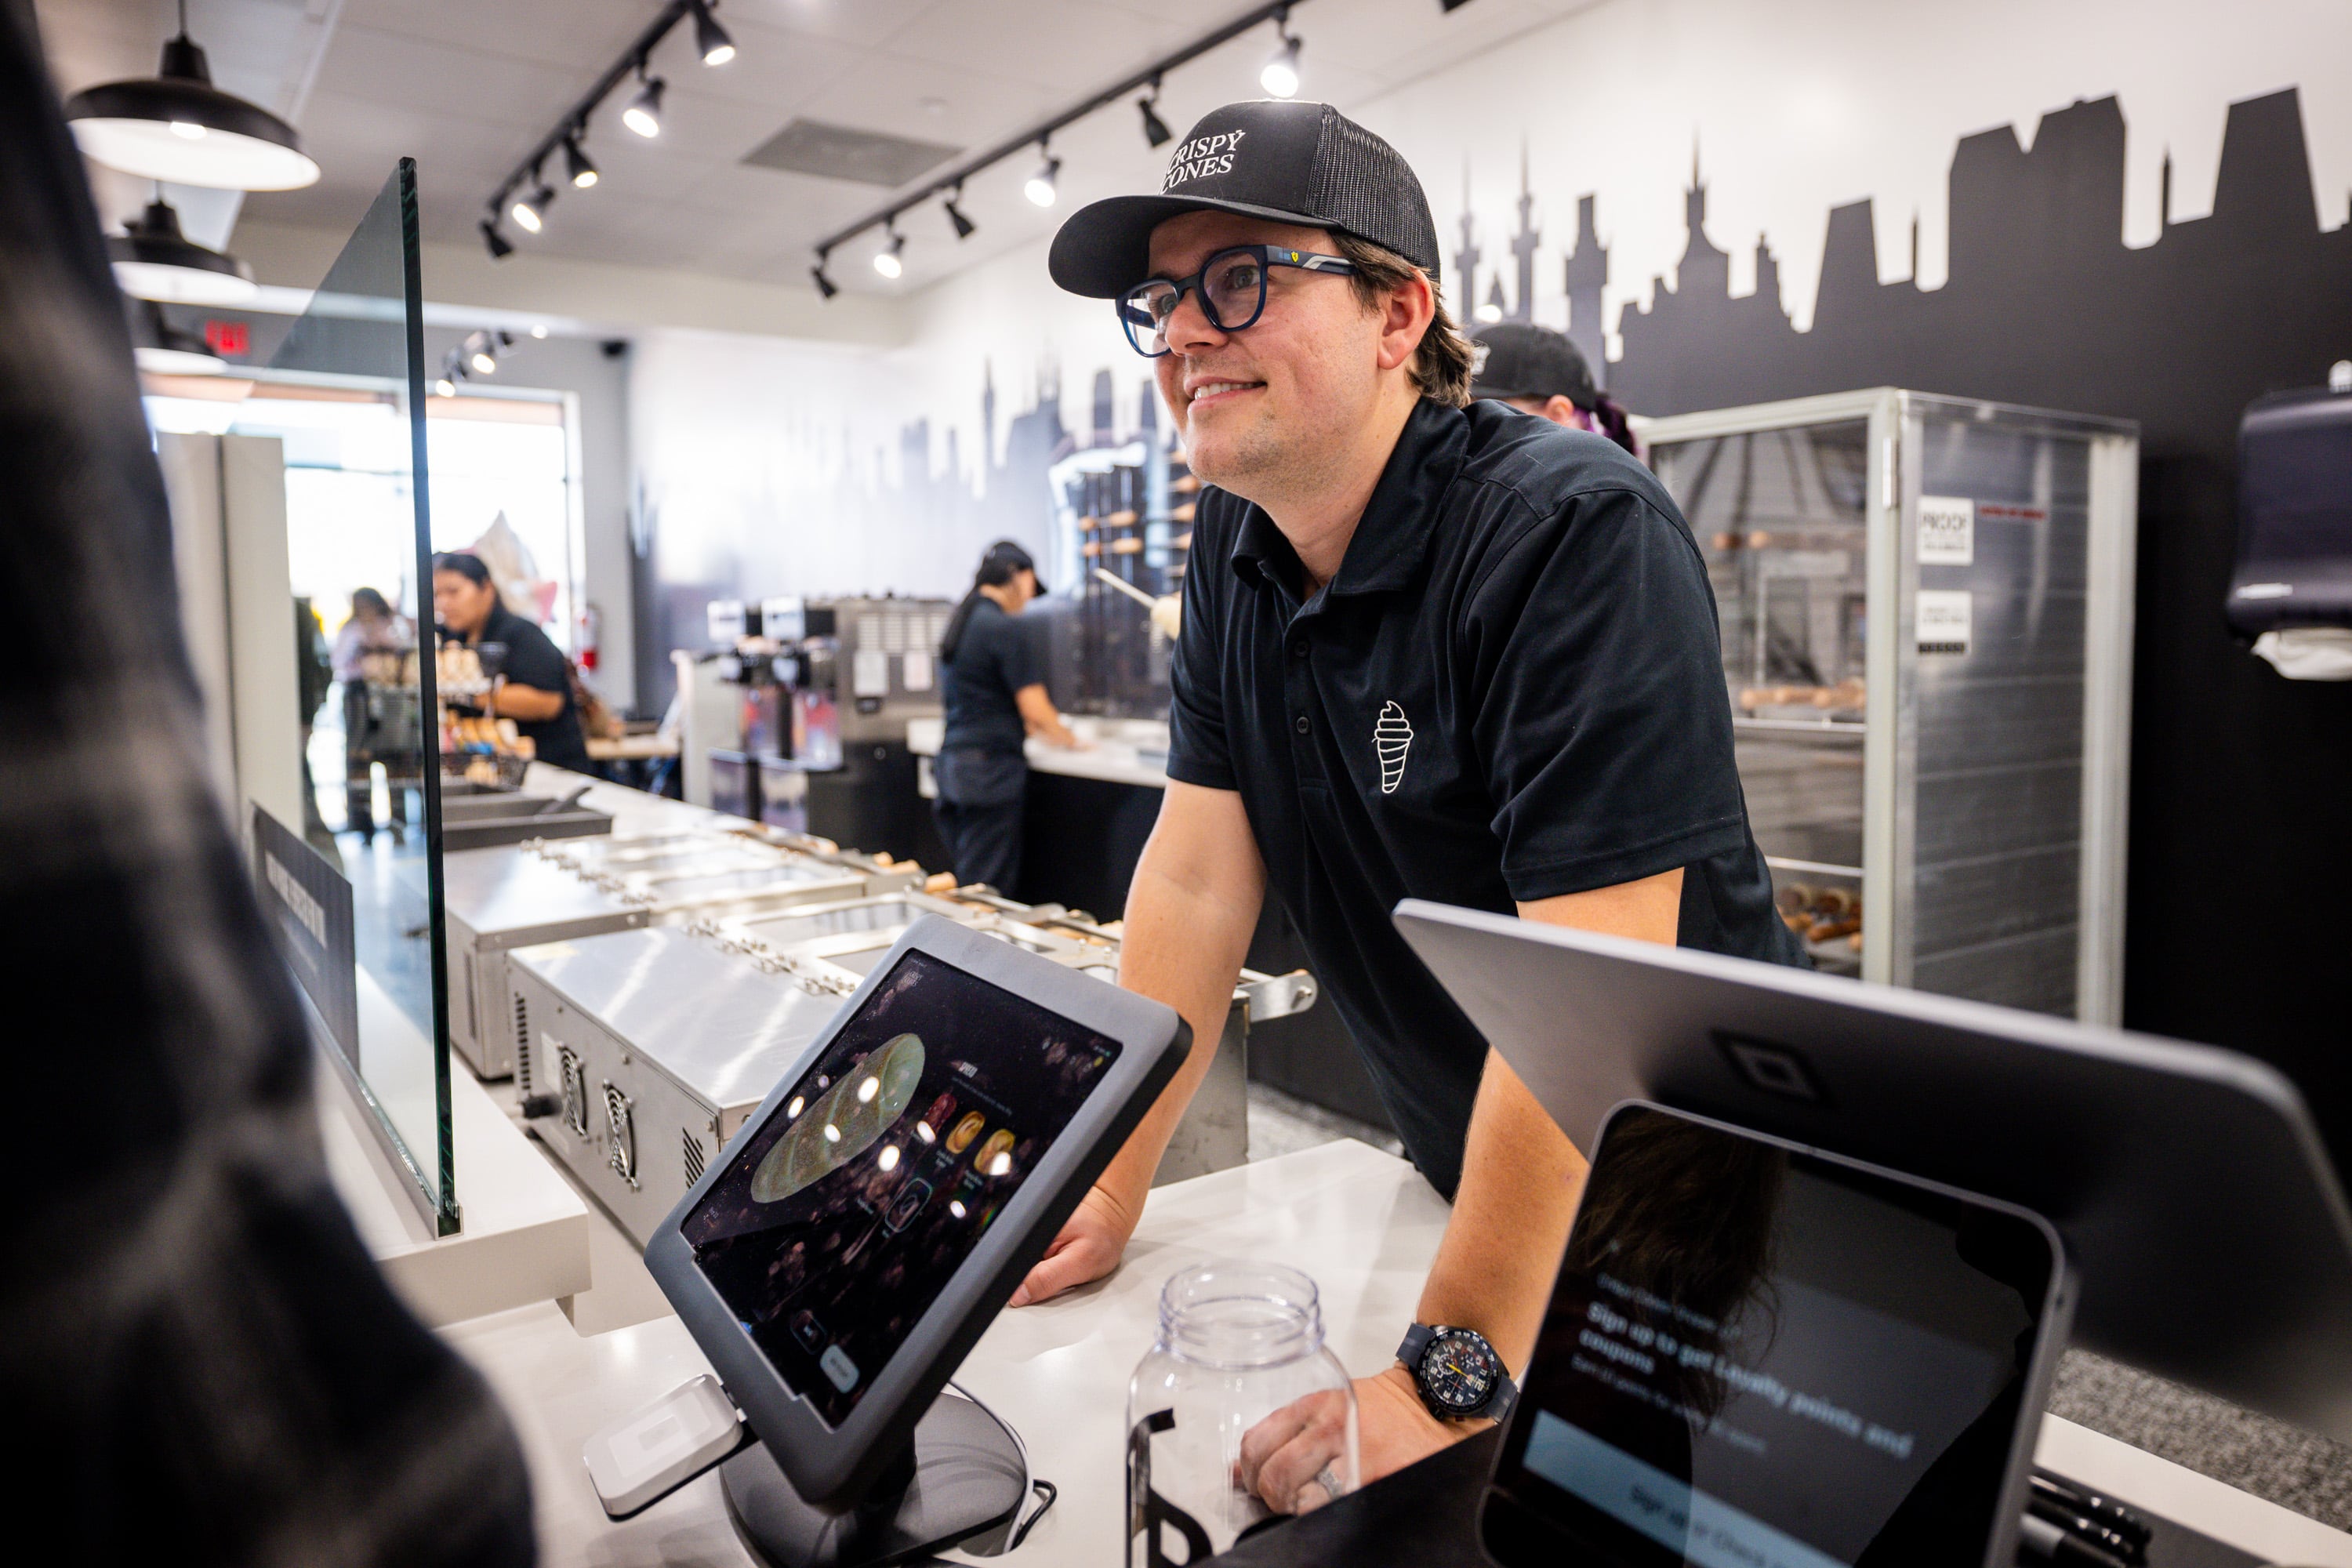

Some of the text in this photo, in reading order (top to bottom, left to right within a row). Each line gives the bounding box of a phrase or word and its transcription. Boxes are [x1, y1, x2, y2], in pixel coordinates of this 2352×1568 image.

[1160, 154, 1235, 195] CONES
[1167, 129, 1246, 175] CRISPY
[1579, 1328, 1655, 1374] coupons
[1587, 1301, 1628, 1333] Sign
[1628, 1323, 1655, 1346] up
[1656, 1332, 1678, 1356] to
[1679, 1345, 1715, 1370] get
